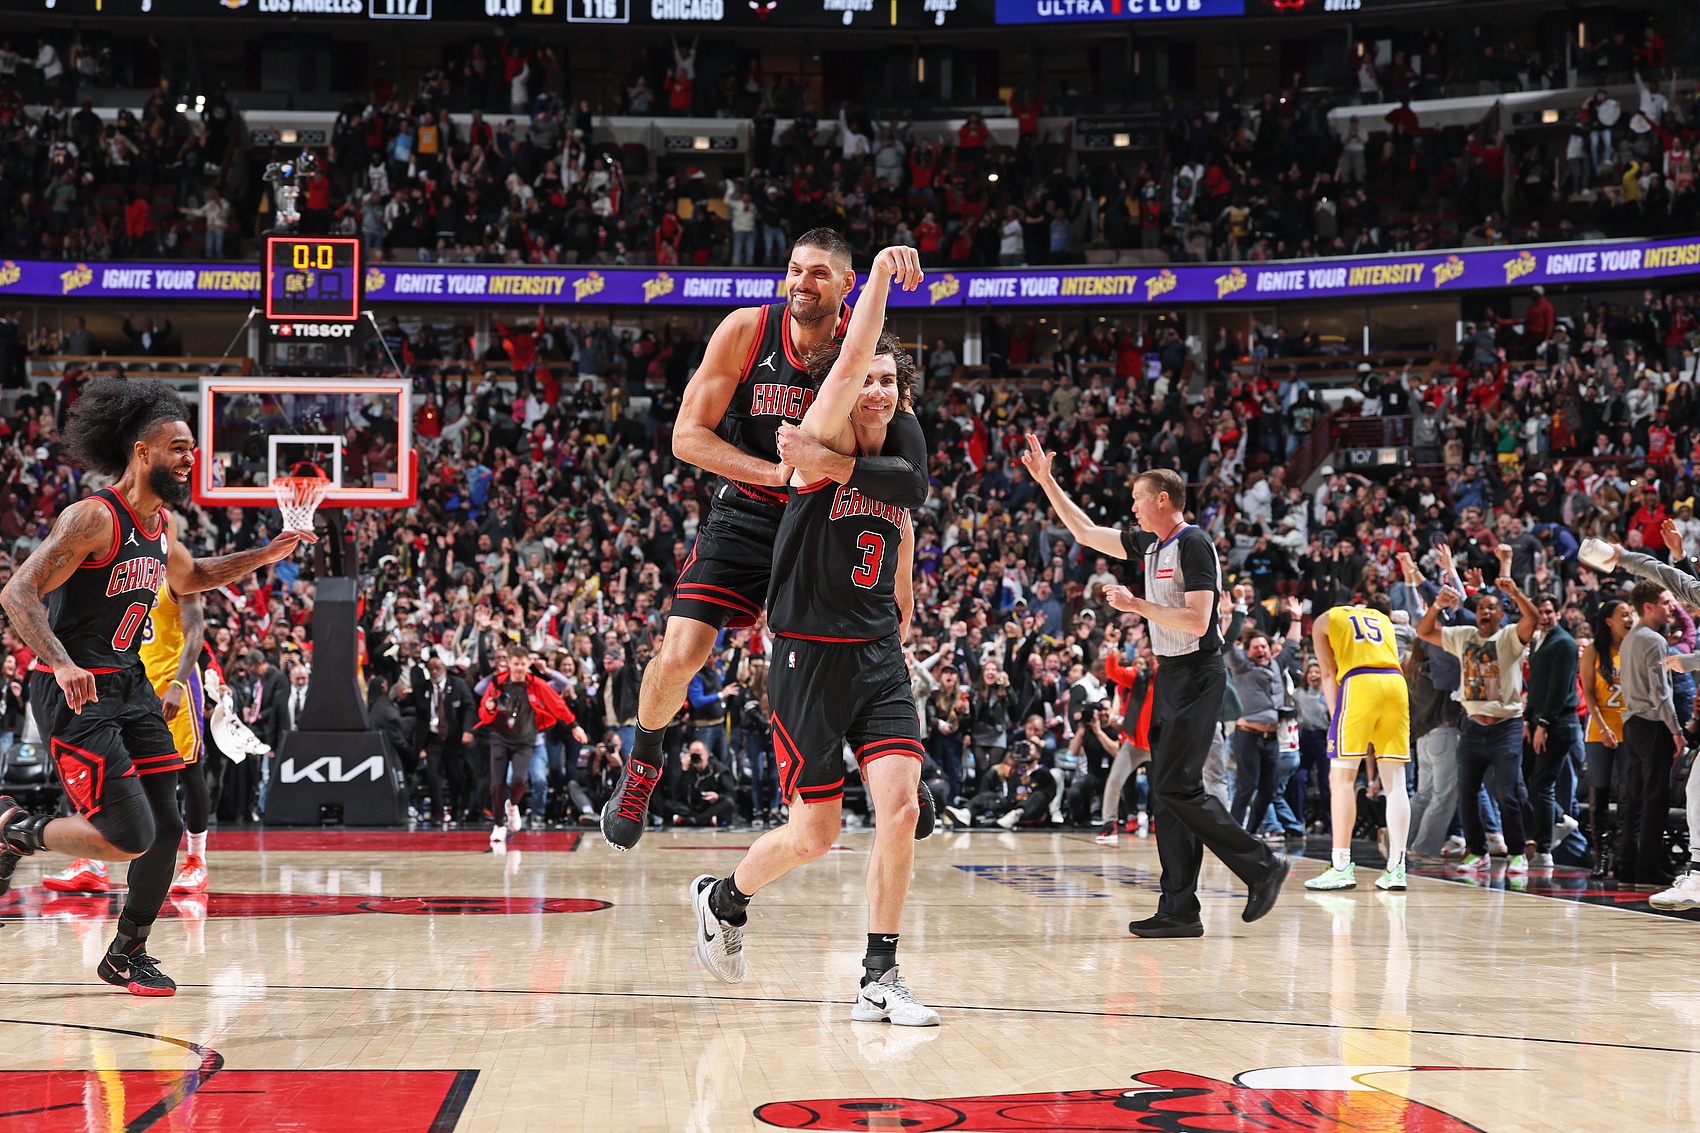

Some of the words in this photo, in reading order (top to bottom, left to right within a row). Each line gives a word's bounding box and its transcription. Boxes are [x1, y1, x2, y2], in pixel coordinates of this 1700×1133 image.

[258, 0, 291, 12] LOS
[292, 0, 363, 14] ANGELES
[583, 0, 617, 18] 116
[651, 0, 724, 20] CHICAGO
[1037, 0, 1105, 16] ULTRA
[293, 244, 333, 269] 0.0
[1503, 254, 1537, 285] Takis
[1545, 252, 1597, 275] IGNITE
[1600, 249, 1642, 271] YOUR
[1643, 244, 1700, 269] INTENSI
[60, 266, 93, 294] Takis
[103, 270, 151, 289] IGNITE
[155, 271, 195, 290] YOUR
[197, 271, 262, 291] INTENSIT
[394, 273, 444, 293] IGNITE
[446, 274, 486, 294] YOUR
[488, 275, 565, 295] INTENSITY
[968, 278, 1017, 298] IGNITE
[1020, 277, 1059, 297] YOUR
[1061, 275, 1137, 296] INTENSITY
[1144, 272, 1177, 301] Takis
[1214, 271, 1248, 300] Takis
[1256, 270, 1305, 292] IGNITE
[1308, 268, 1347, 290] YOUR
[1349, 263, 1425, 287] INTENSITY
[1431, 258, 1465, 288] Takis
[571, 274, 604, 302] Takis
[642, 275, 675, 303] Takis
[683, 278, 731, 297] IGNITE
[735, 278, 774, 298] YOUR
[292, 324, 354, 337] TISSOT
[750, 384, 814, 420] CHICA
[1350, 450, 1371, 464] 107
[851, 531, 885, 589] 3
[112, 602, 149, 652] 0
[1348, 615, 1384, 645] 15
[280, 755, 384, 783] KIA
